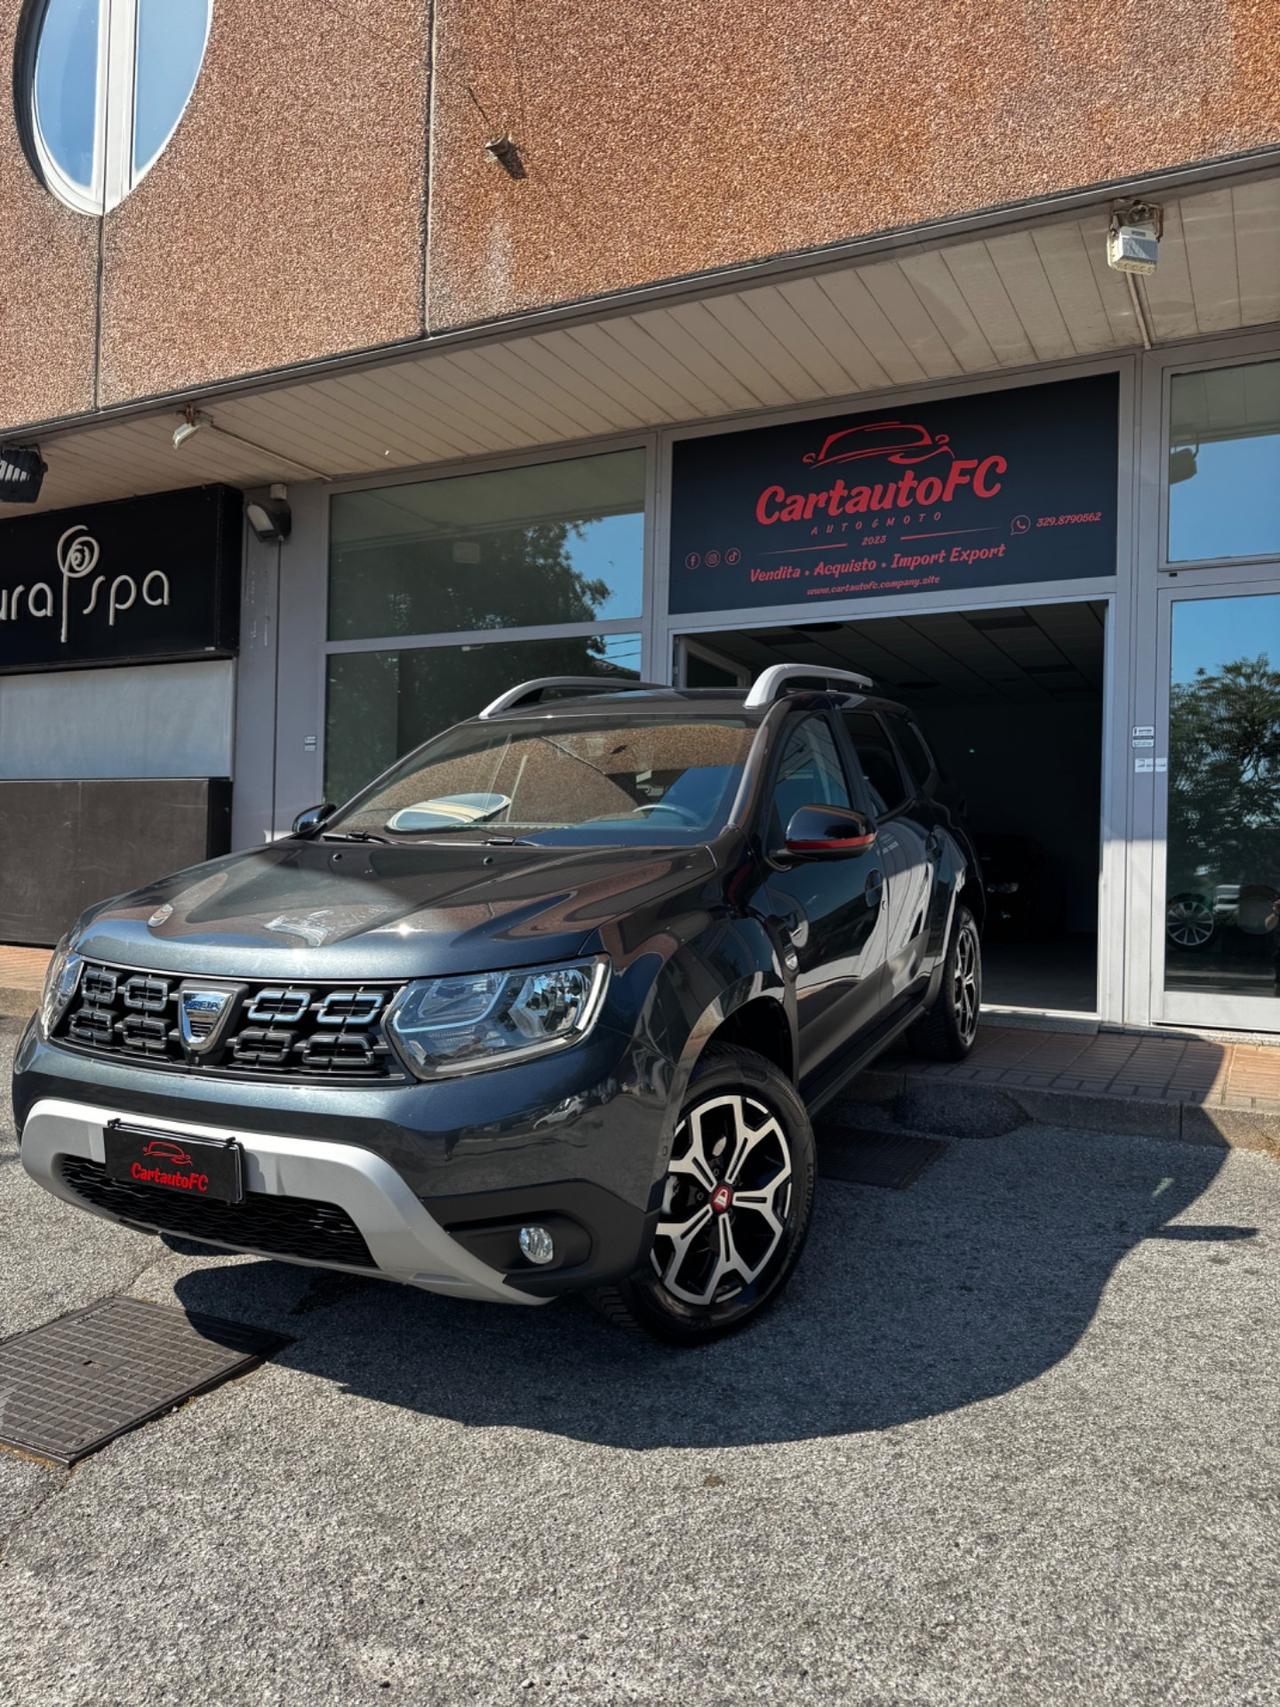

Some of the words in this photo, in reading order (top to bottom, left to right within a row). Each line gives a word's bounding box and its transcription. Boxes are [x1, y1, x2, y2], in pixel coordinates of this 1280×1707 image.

[756, 455, 1008, 525] CartautoFC
[1036, 511, 1103, 528] 329.8790562
[750, 565, 801, 582] Vendita
[814, 557, 877, 578] Acquisto
[891, 549, 946, 570] Import
[949, 543, 1007, 564] Export
[82, 570, 170, 626] spa
[130, 1162, 209, 1193] CartautoFC
